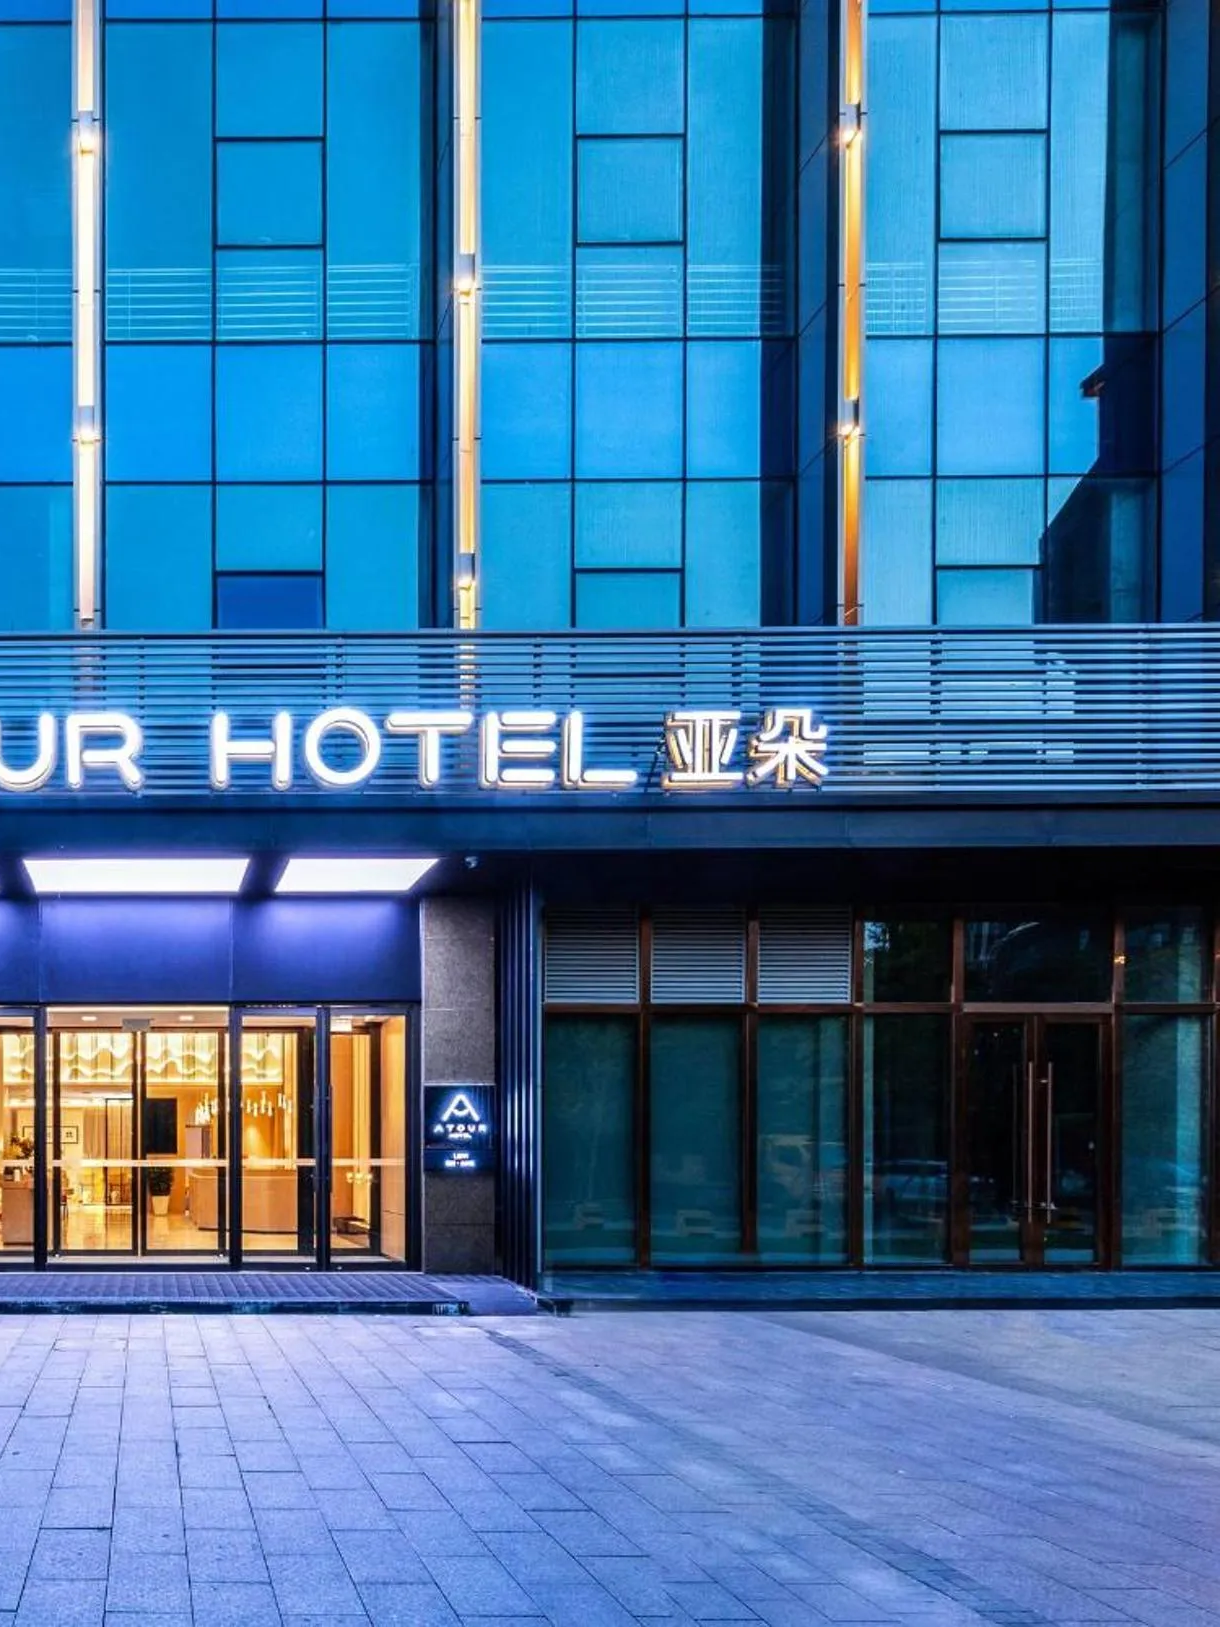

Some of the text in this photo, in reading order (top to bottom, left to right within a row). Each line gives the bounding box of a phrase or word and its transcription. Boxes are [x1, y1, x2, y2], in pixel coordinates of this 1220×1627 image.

[207, 706, 638, 792] HOTEL
[662, 708, 831, 790] 亚朵
[433, 1123, 488, 1133] ATOUR
